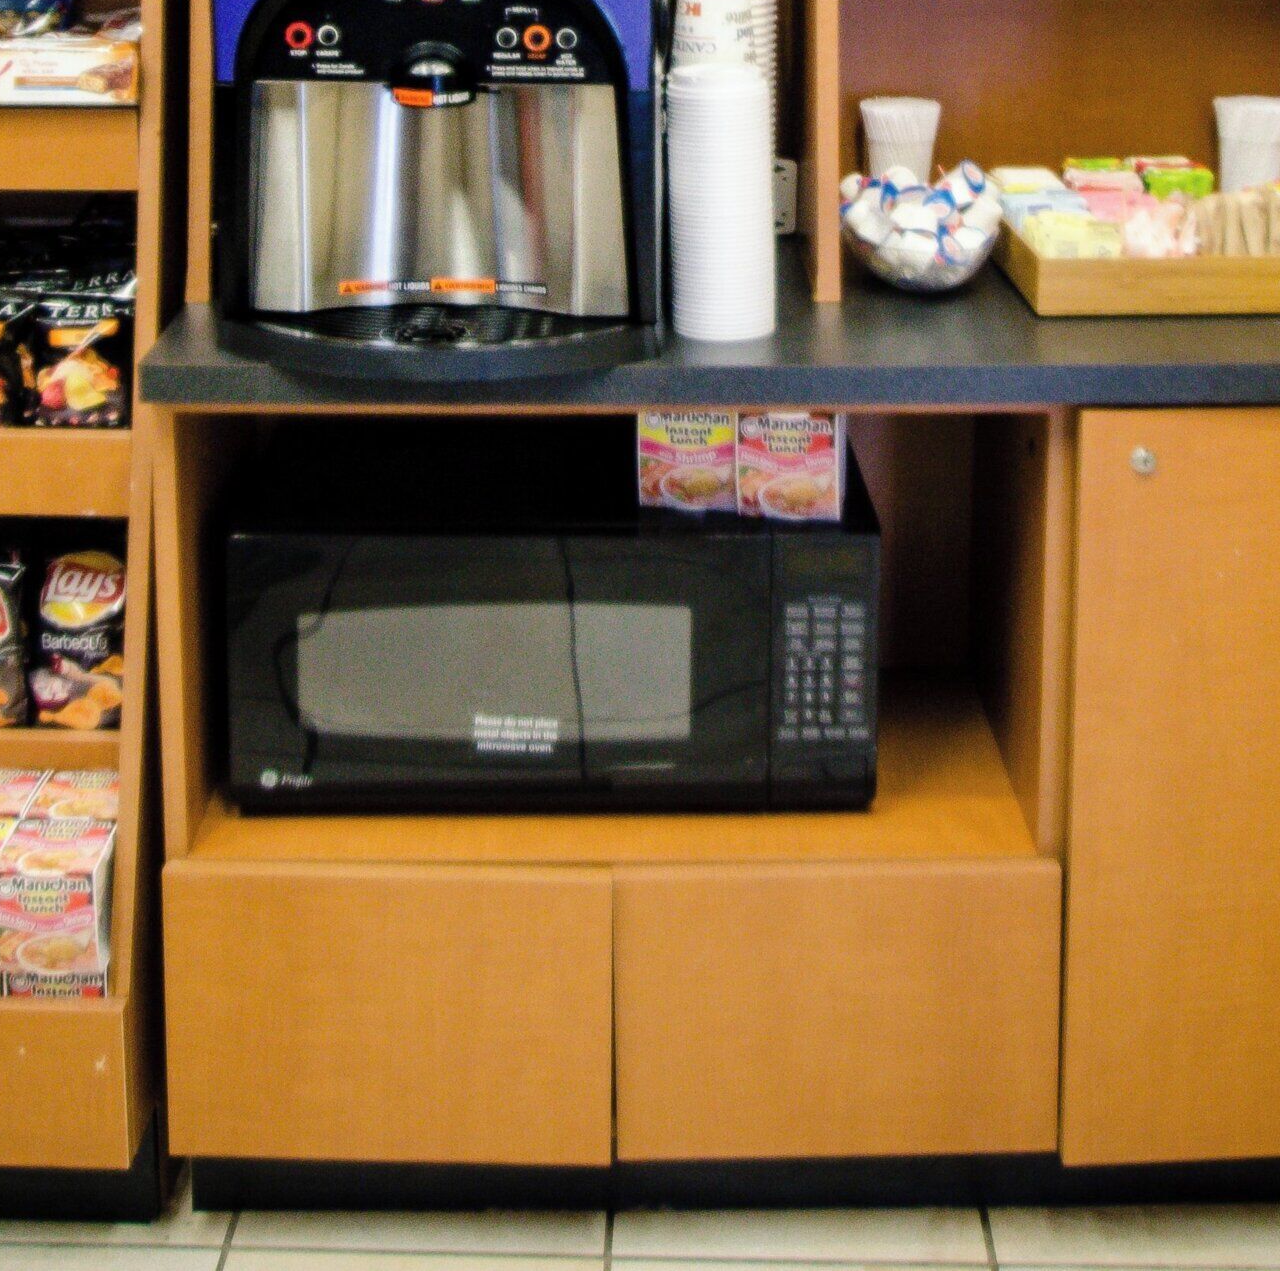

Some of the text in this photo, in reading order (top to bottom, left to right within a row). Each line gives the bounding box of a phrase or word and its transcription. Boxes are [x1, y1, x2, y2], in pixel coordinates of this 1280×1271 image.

[11, 876, 89, 892] Maruchan
[16, 894, 68, 905] Instant
[22, 904, 64, 914] Lunch
